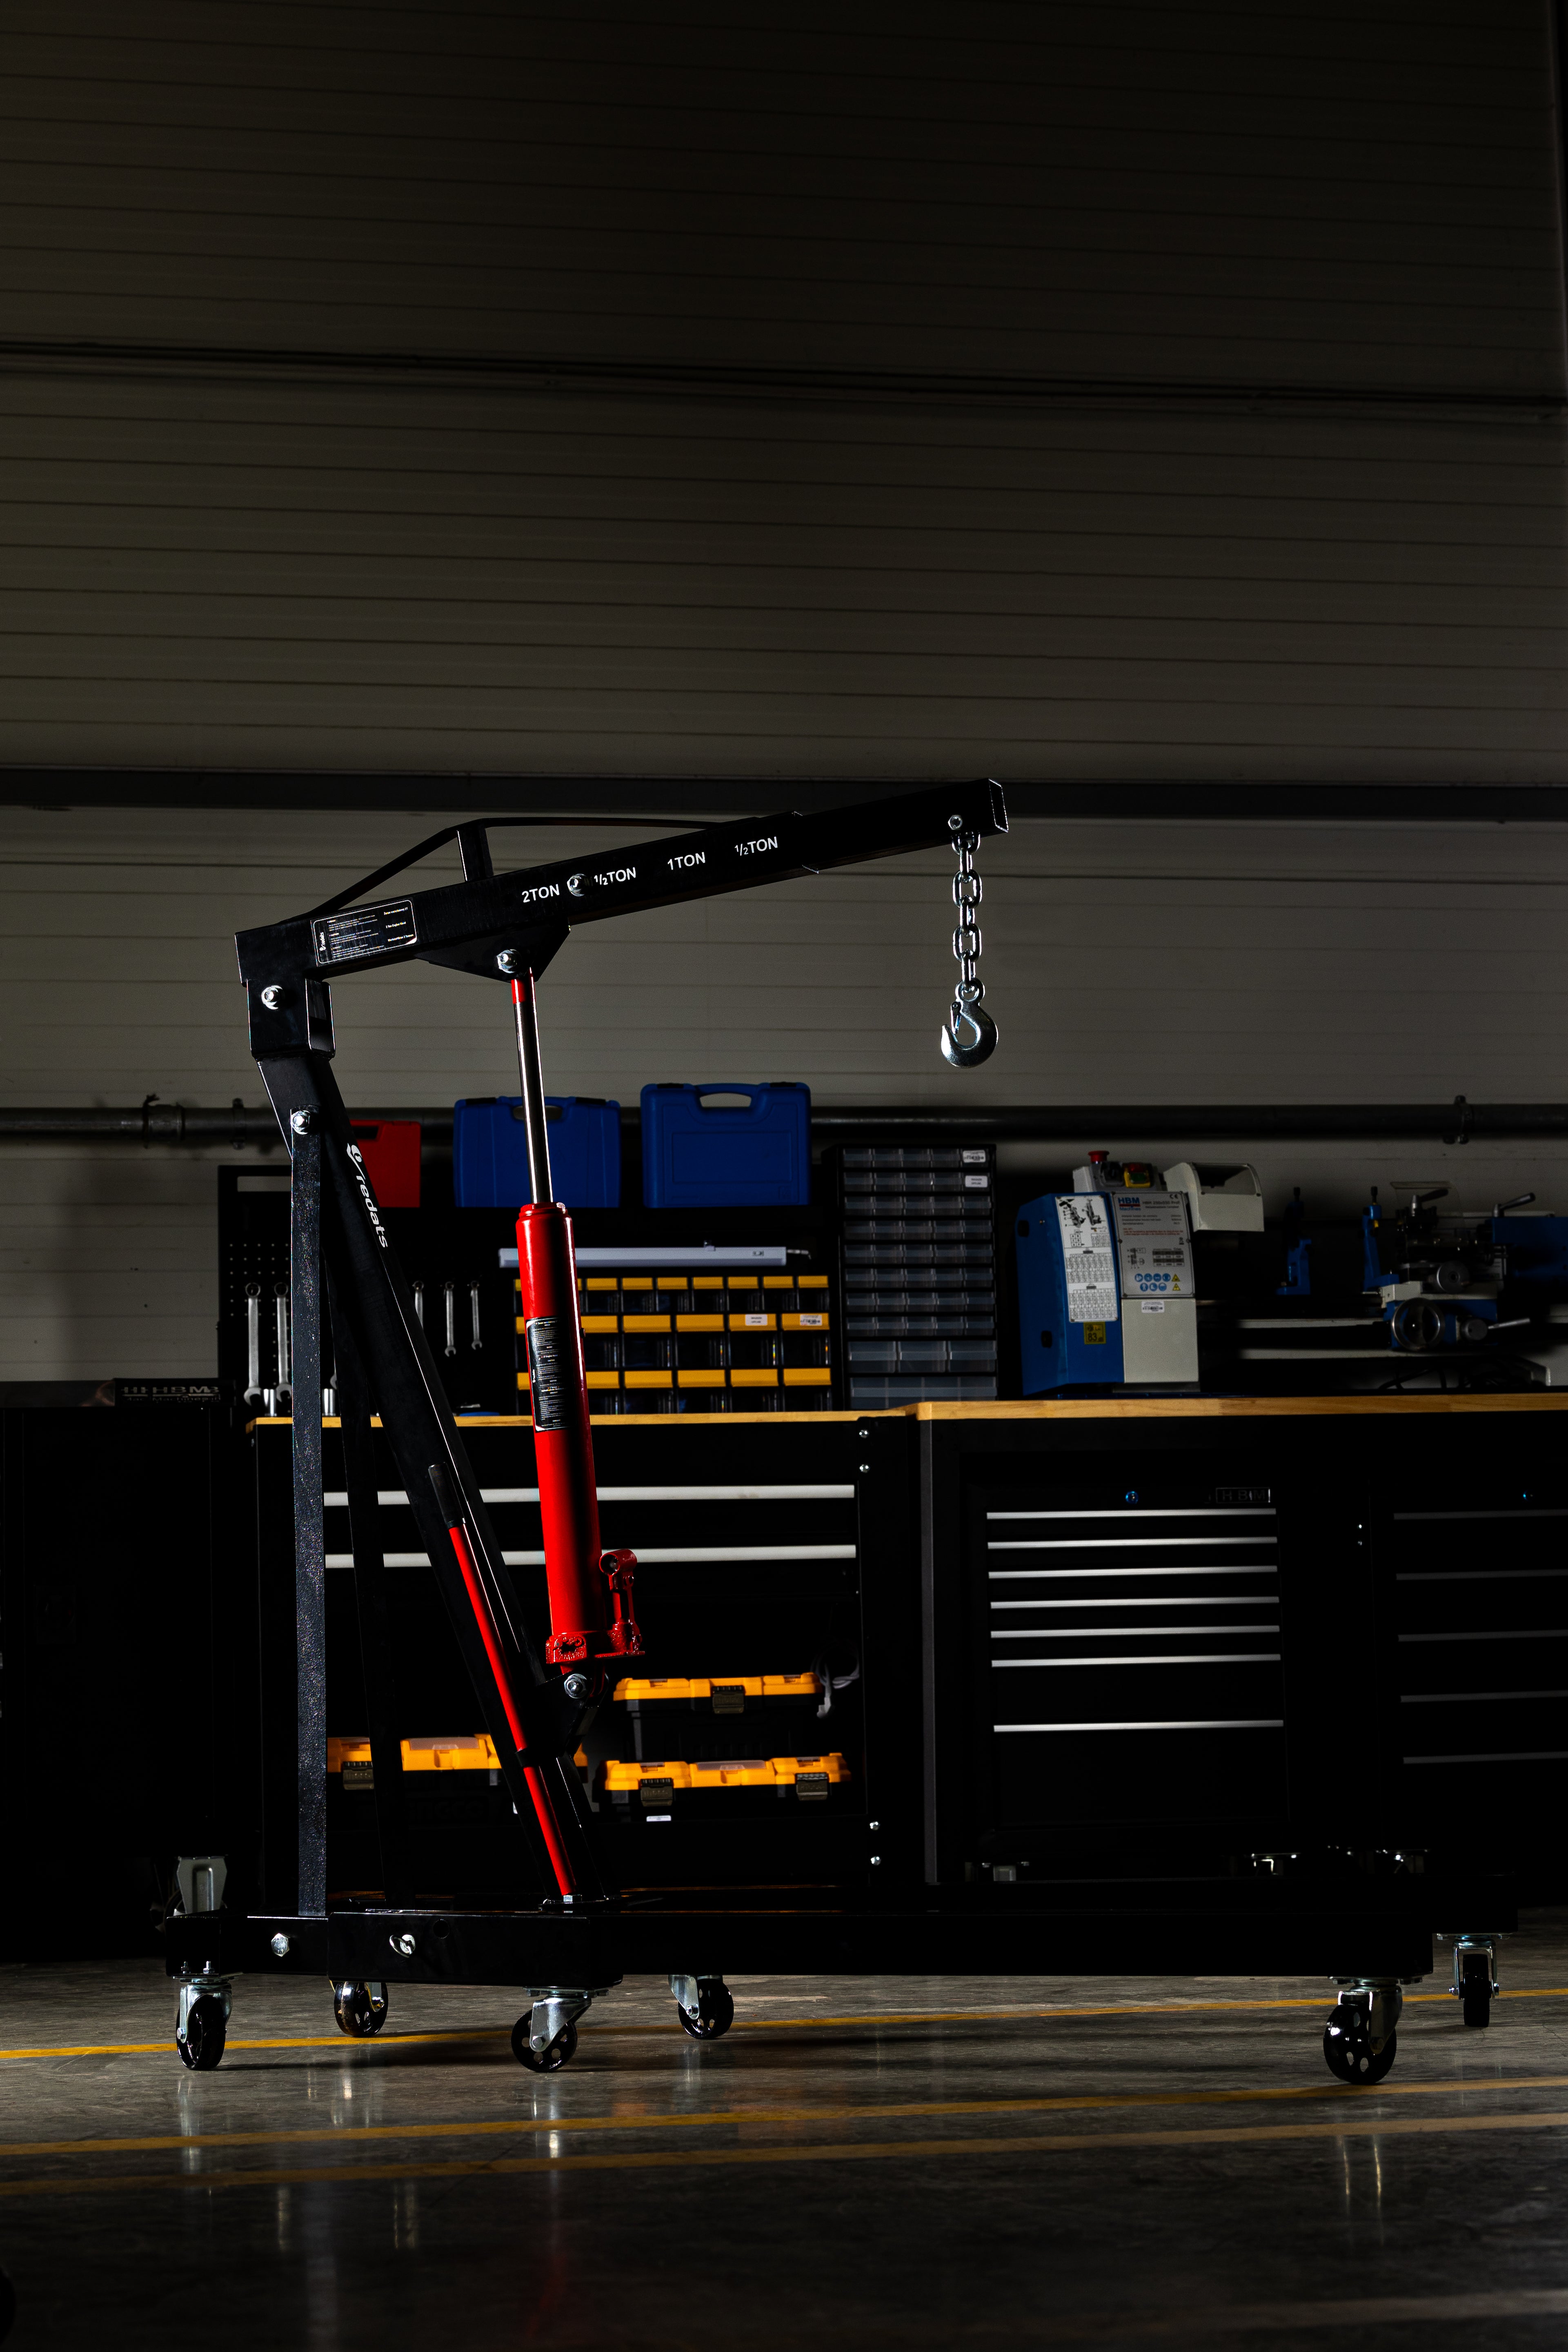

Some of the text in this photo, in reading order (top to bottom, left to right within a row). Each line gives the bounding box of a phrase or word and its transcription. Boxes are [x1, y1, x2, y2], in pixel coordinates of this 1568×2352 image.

[522, 883, 560, 903] 2TON
[667, 852, 706, 870] 1TON
[356, 1174, 388, 1248] redats
[1088, 1332, 1097, 1342] 83
